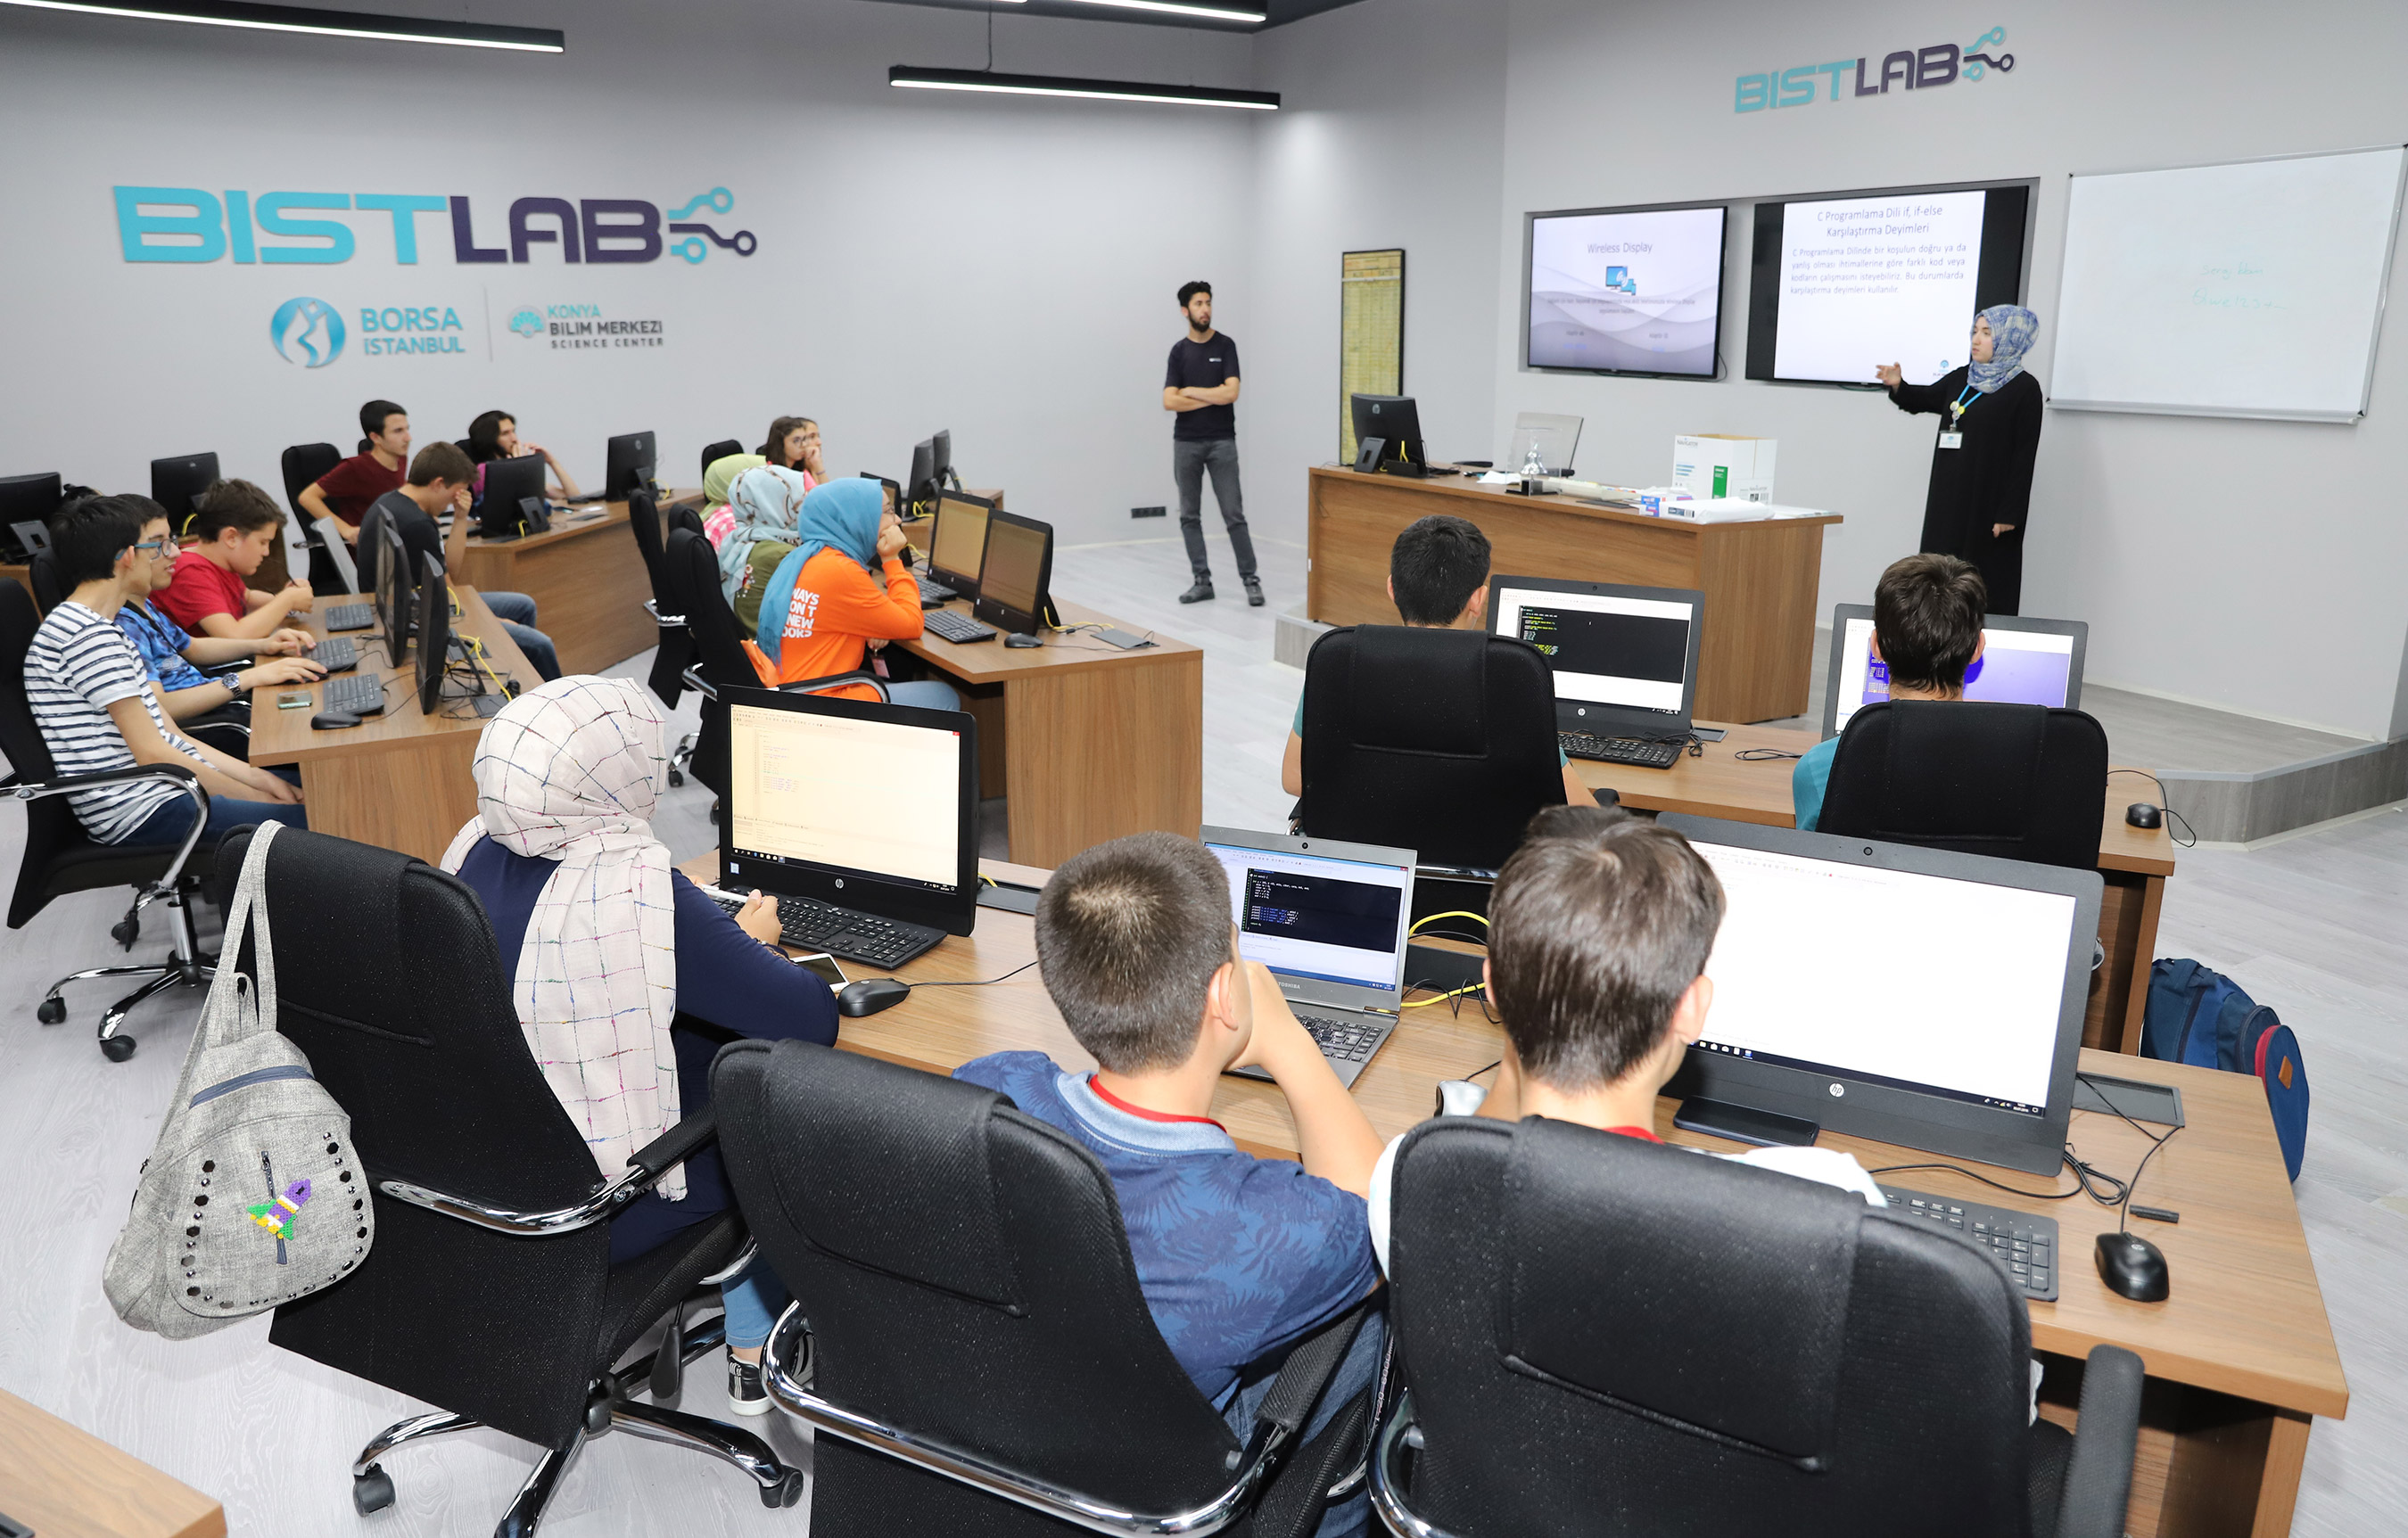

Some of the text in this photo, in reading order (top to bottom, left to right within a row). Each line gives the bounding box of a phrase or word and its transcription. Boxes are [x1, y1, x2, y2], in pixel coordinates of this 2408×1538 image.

[1735, 44, 1959, 112] BISTLAB
[1818, 212, 1823, 221] C
[1826, 209, 1884, 223] Programlama
[1886, 208, 1901, 218] Dili
[1914, 205, 1942, 217] if-else
[113, 185, 663, 265] BISTLAB
[1827, 223, 1929, 239] Karşılaştırma Deyimleri
[1587, 242, 1653, 255] Wireless Display
[1800, 248, 1844, 258] Programlama
[1918, 244, 1942, 254] doğru
[1957, 243, 1967, 251] da
[547, 304, 601, 318] KONYA
[360, 307, 463, 332] BORSA
[551, 338, 664, 349] SCIENCE CENTER
[786, 613, 814, 629] NEW
[1829, 1082, 1844, 1097] hp
